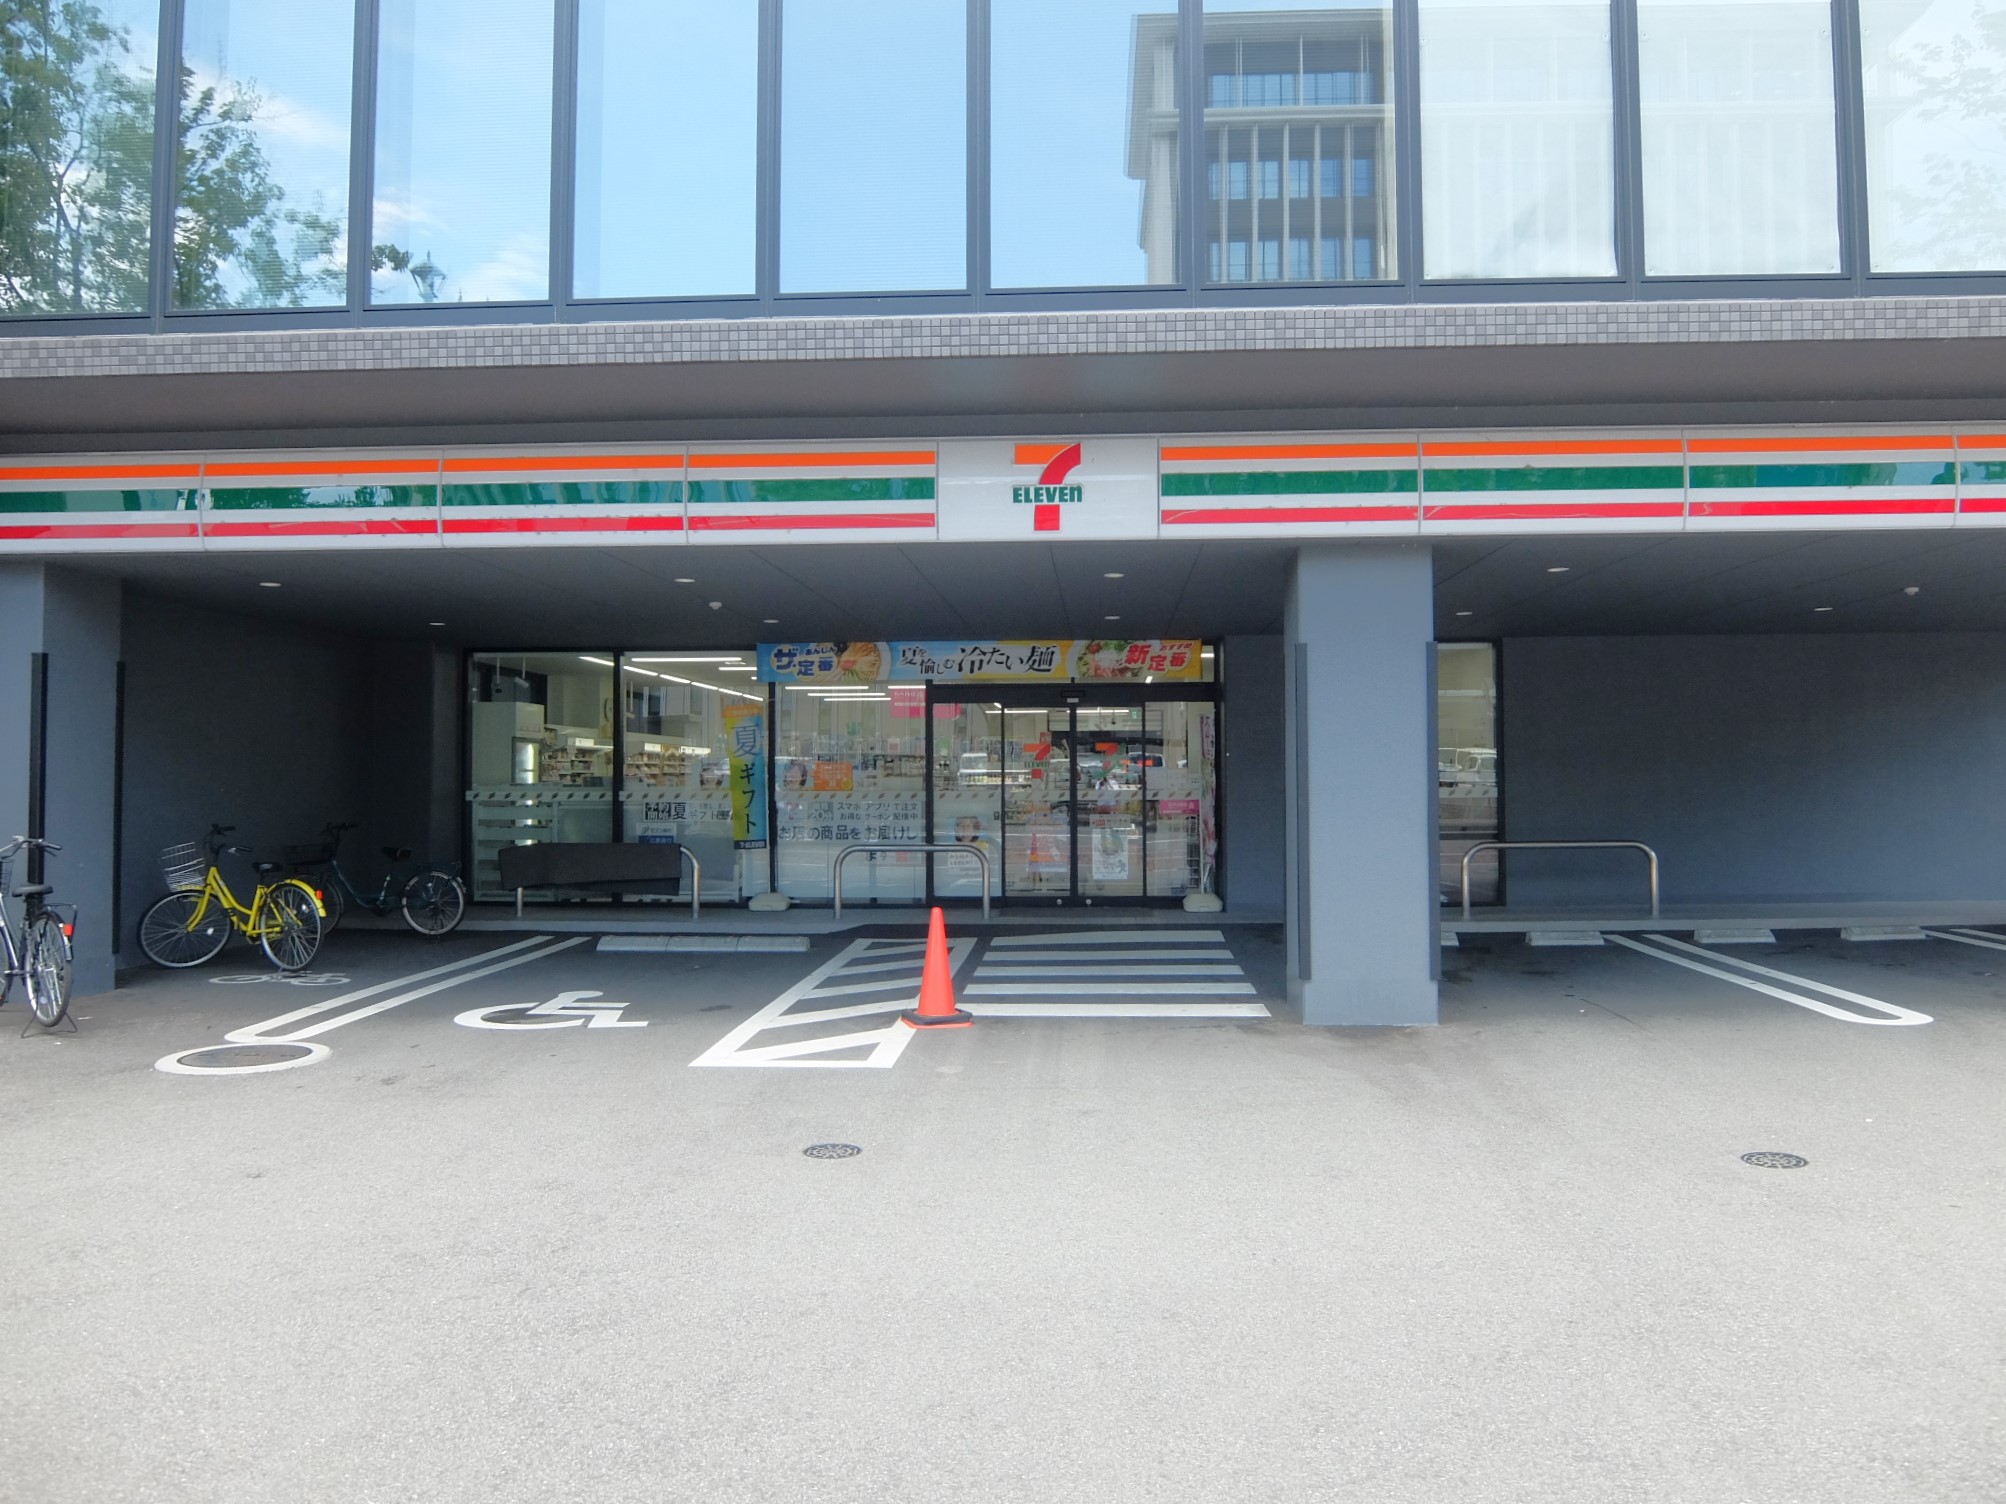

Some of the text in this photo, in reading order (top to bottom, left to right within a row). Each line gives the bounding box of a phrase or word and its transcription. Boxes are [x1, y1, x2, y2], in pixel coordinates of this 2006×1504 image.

[1014, 442, 1082, 531] 7
[1126, 644, 1187, 672] 新定番
[732, 725, 760, 834] 夏ギフト
